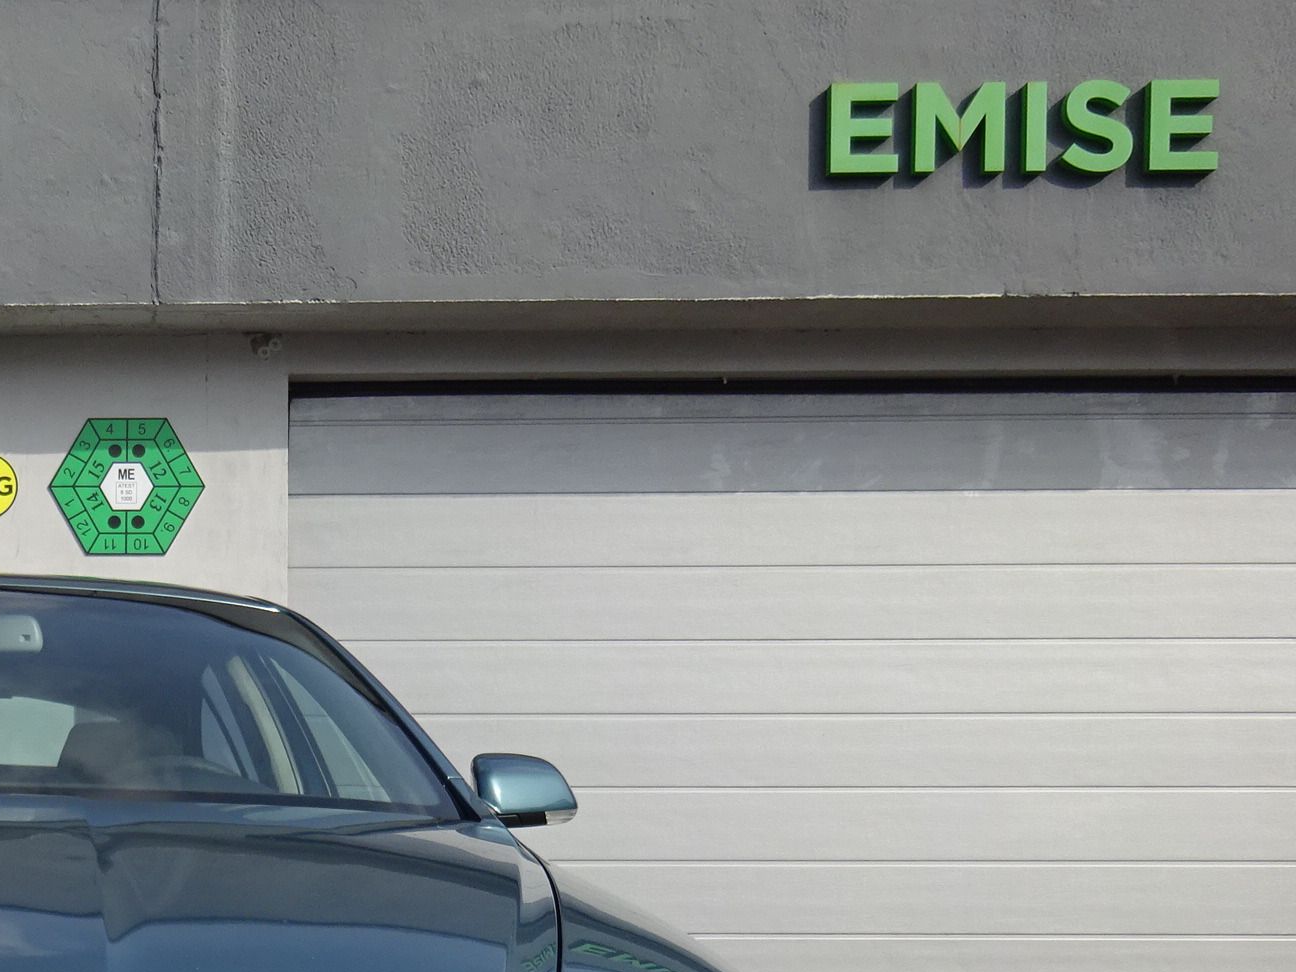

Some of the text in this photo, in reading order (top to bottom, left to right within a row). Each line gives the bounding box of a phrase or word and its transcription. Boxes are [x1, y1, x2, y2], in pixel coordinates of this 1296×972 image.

[826, 79, 1221, 177] EMISE
[106, 423, 114, 435] 4
[138, 423, 146, 435] 5
[79, 440, 91, 451] 3
[63, 467, 76, 479] 2
[87, 460, 104, 480] 15
[117, 468, 135, 480] ME
[149, 460, 167, 480] 12
[179, 467, 192, 476] 7
[64, 498, 75, 507] 1
[86, 491, 105, 511] 14
[149, 493, 167, 512] 13
[178, 496, 190, 507] 8
[76, 519, 92, 537] 12
[104, 538, 117, 550] 11
[133, 538, 149, 550] 10
